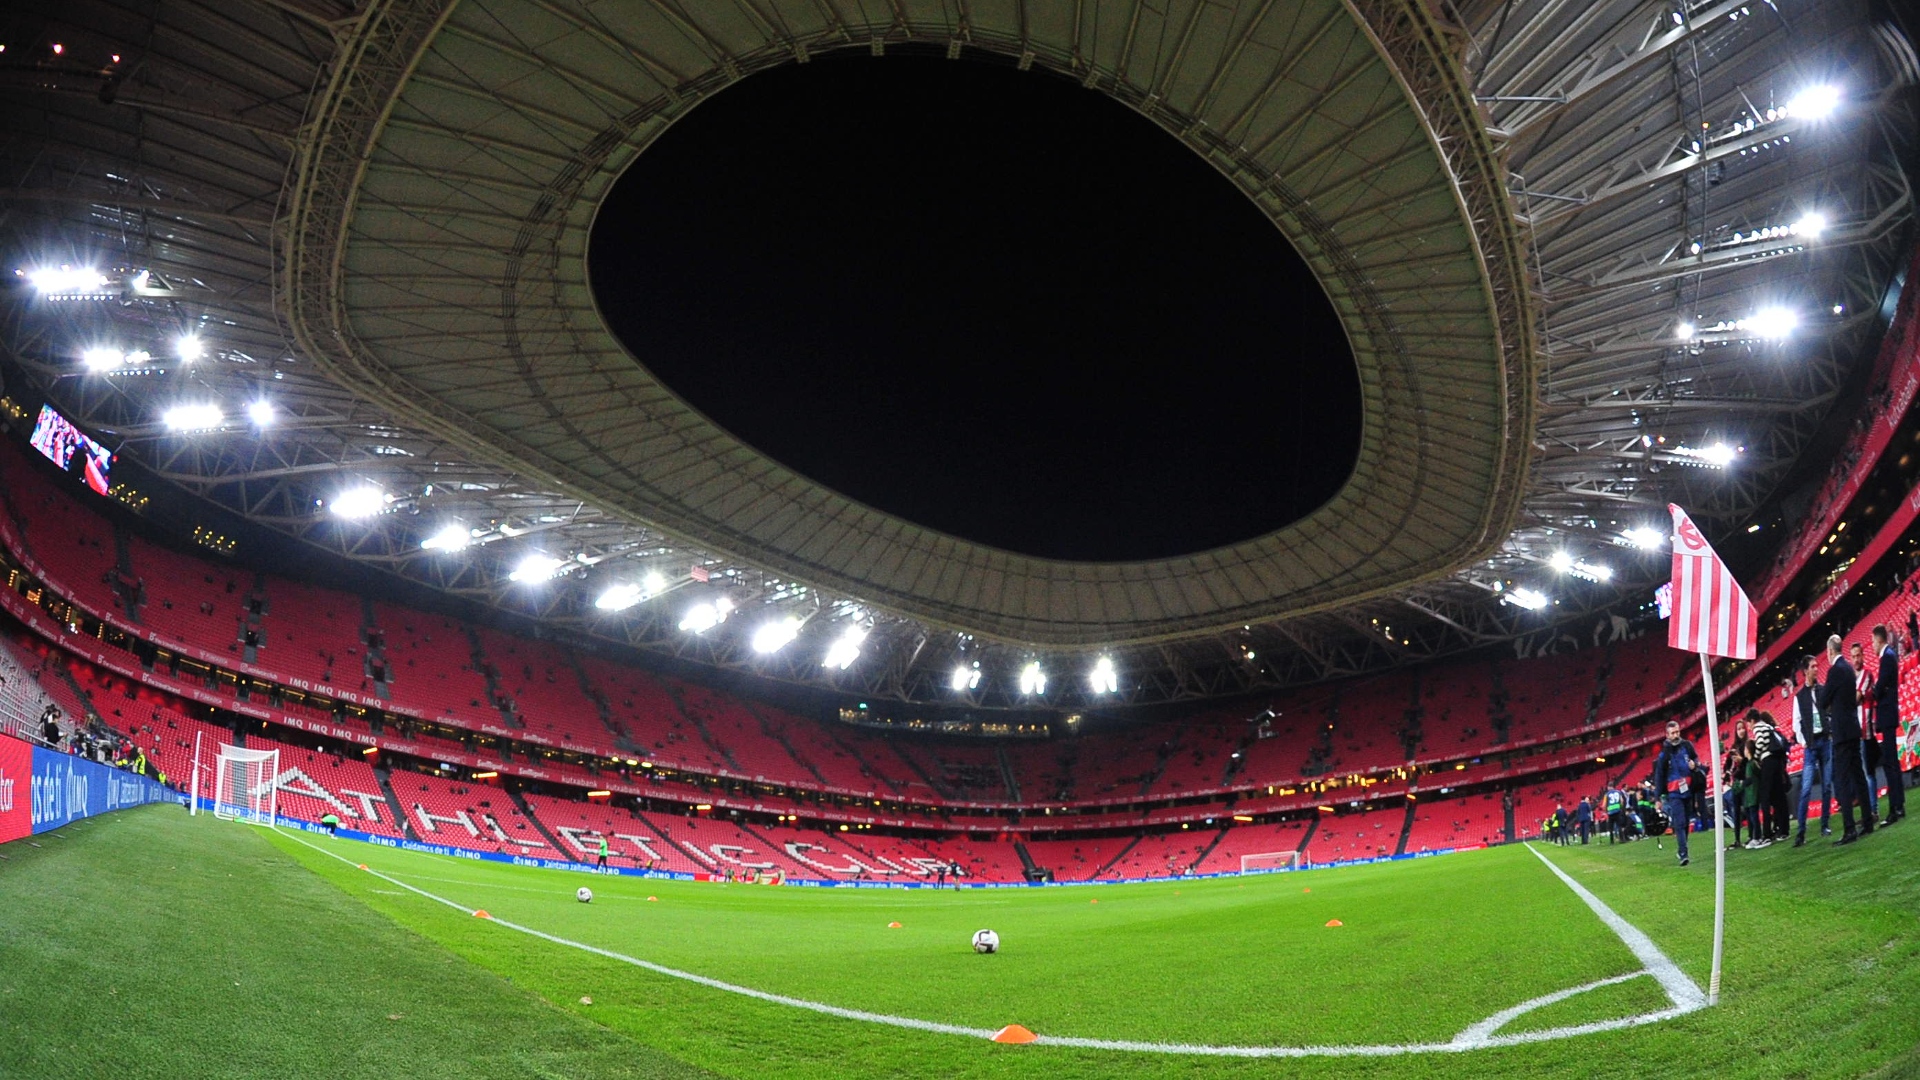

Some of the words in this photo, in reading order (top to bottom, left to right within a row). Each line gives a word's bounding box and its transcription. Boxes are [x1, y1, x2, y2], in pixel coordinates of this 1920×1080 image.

[290, 677, 309, 690] IMQ
[314, 684, 333, 696] IMQ
[338, 690, 357, 702] IMQ
[362, 696, 382, 708] IMQ
[284, 716, 303, 729] IMQ
[308, 723, 328, 735] IMQ
[333, 728, 352, 741] IMQ
[357, 734, 377, 746] IMQ
[43, 761, 55, 822] de
[1608, 791, 1620, 804] 39
